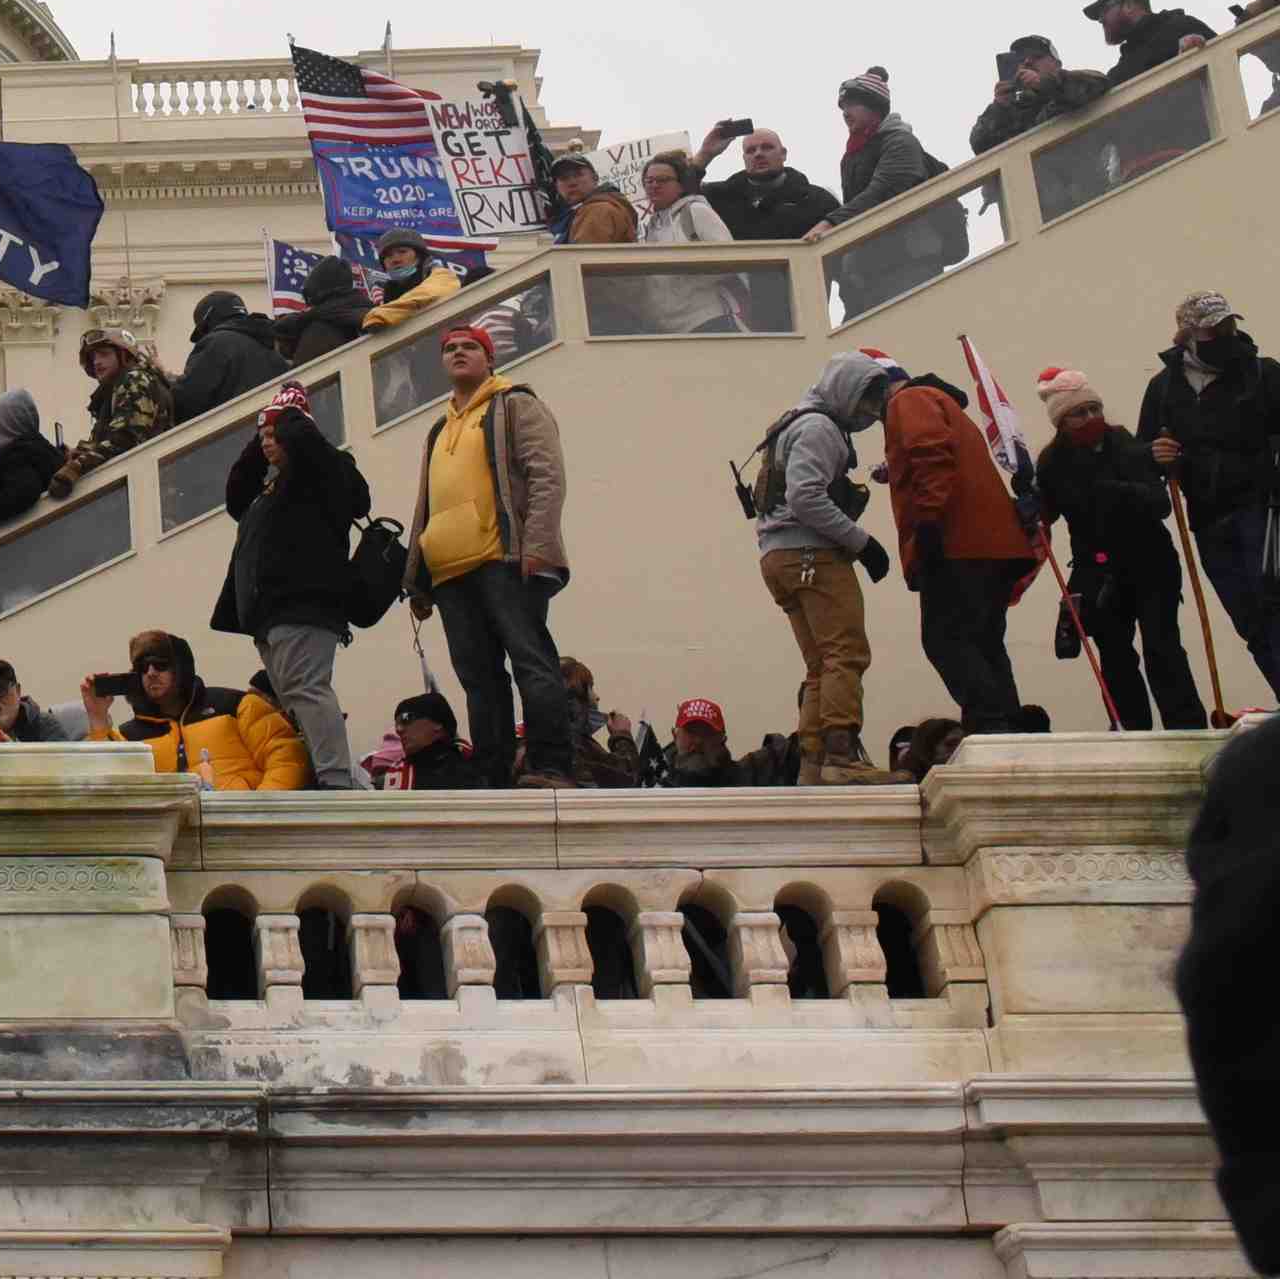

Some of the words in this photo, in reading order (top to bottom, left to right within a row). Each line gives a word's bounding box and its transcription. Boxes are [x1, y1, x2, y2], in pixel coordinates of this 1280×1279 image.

[431, 101, 473, 130] NEW
[441, 130, 511, 157] GET
[451, 154, 528, 188] REKT
[343, 206, 373, 218] KEEP
